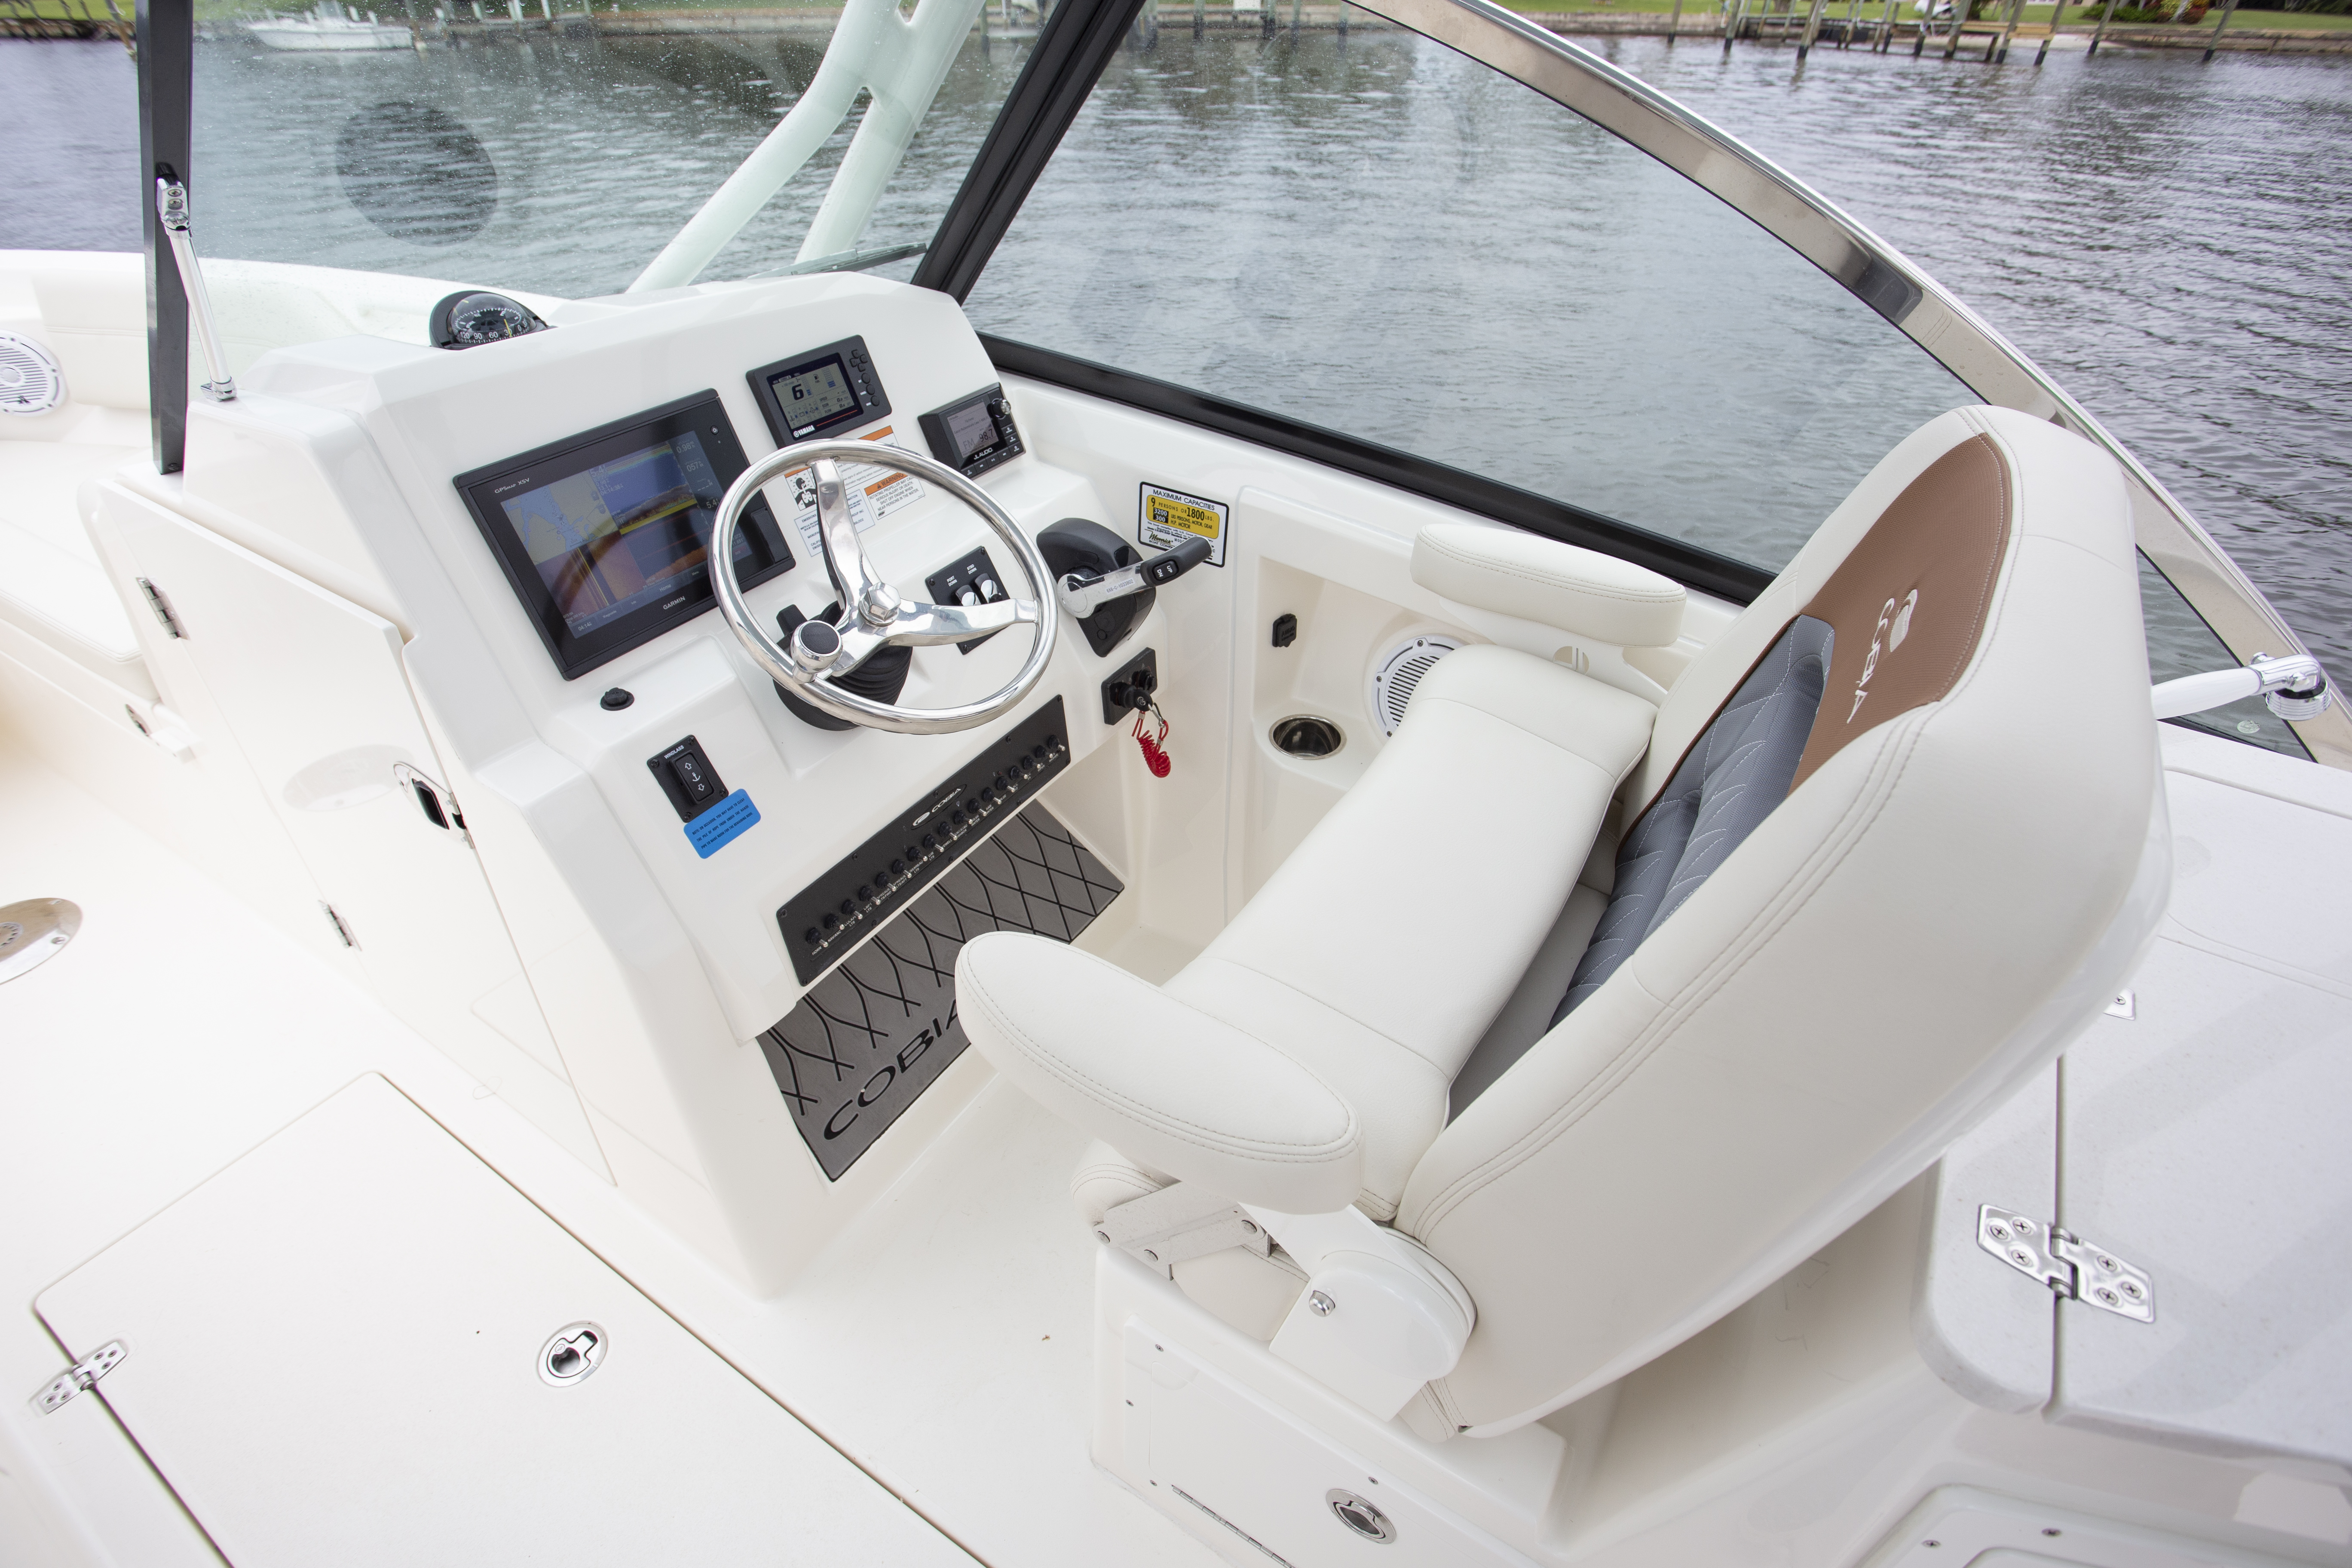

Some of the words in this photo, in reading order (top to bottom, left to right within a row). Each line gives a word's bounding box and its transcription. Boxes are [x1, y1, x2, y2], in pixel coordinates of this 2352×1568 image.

[792, 383, 804, 400] 6
[798, 425, 815, 435] YAMAHA
[963, 438, 975, 449] FM
[979, 429, 993, 442] 98.7
[676, 442, 691, 453] 0.98
[980, 448, 993, 457] AUDIO
[881, 472, 903, 486] WARNING
[869, 490, 883, 499] ROTATING
[883, 482, 900, 492] PROPELLER
[876, 493, 888, 501] SERIOUS
[886, 498, 899, 507] PERSONS
[1153, 489, 1182, 501] MAXIMUM
[1184, 498, 1215, 511] CAPACITIES
[1151, 497, 1155, 506] 9
[1159, 502, 1178, 511] PERSONS
[1187, 507, 1204, 521] 1800
[802, 514, 816, 522] EMISSIONS
[1177, 515, 1191, 524] PERSONS,
[1149, 532, 1171, 544] Maverick
[948, 579, 958, 587] DOWN
[1106, 579, 1134, 593] 6X6-C-1033802
[663, 596, 685, 609] GARMIN
[664, 745, 684, 759] WINDLASS
[932, 788, 961, 812] COBIA
[733, 816, 746, 826] REMAINING
[896, 878, 906, 888] LTS/AFT
[828, 930, 842, 942] NAV/ANC
[812, 946, 822, 956] HORN
